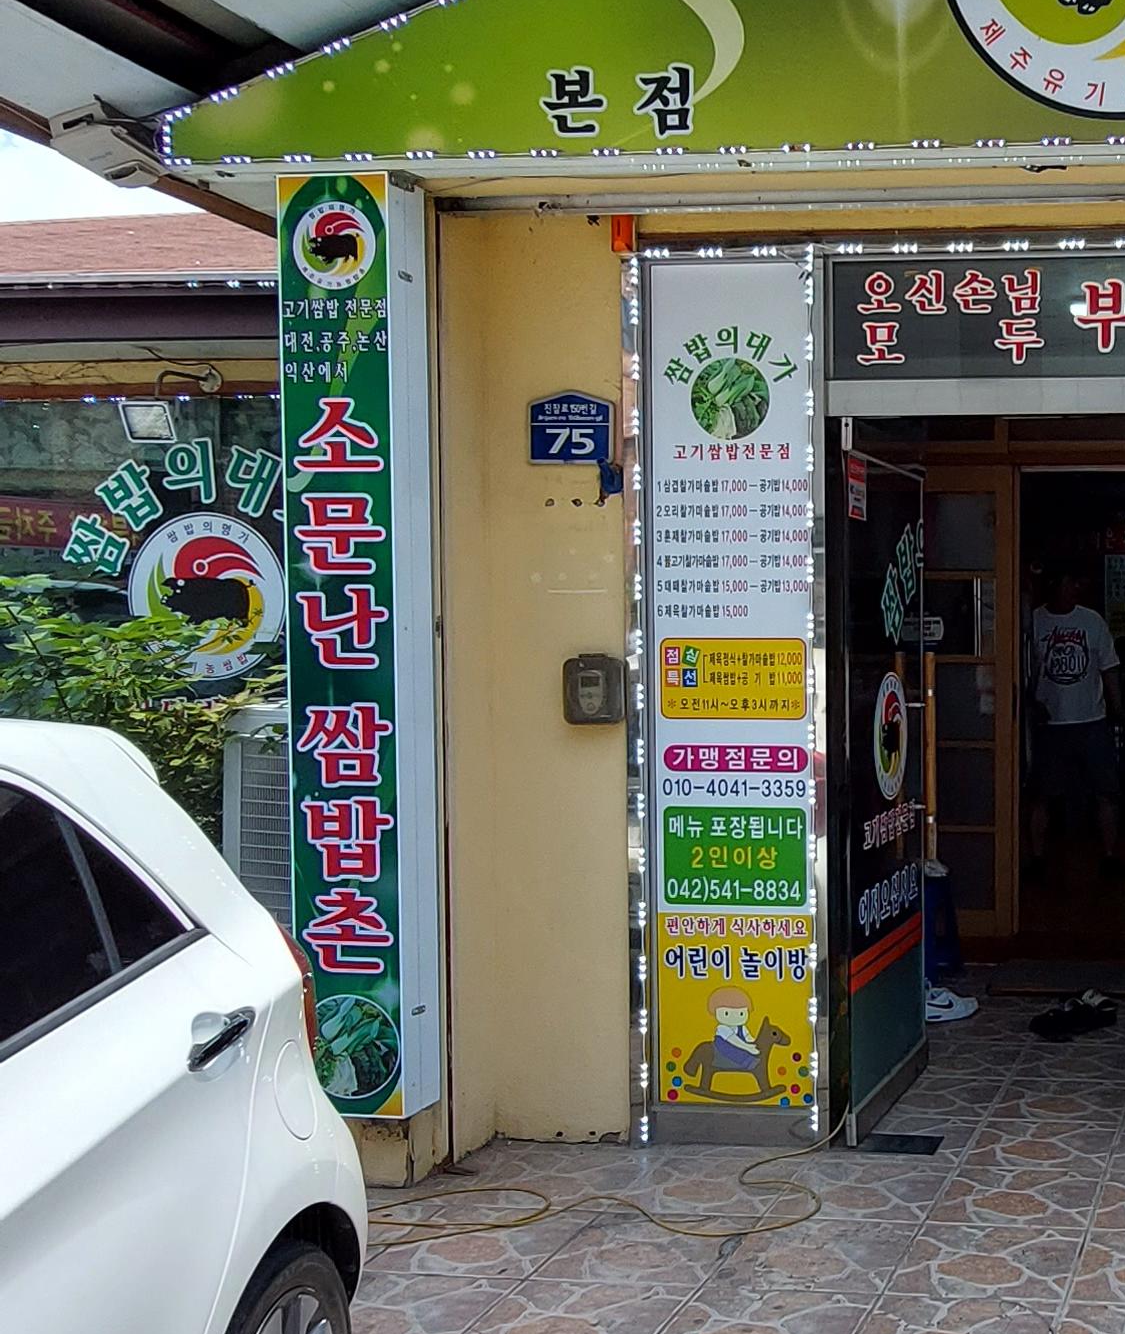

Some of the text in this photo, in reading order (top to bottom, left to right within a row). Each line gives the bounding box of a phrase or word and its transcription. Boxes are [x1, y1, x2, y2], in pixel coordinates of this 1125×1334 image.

[857, 269, 1043, 317] 오신손님
[283, 297, 387, 319] 고기쌈밥 전문점
[663, 325, 799, 386] 쌈밥의대가
[285, 361, 349, 383] 익산에서
[545, 427, 595, 455] 75
[673, 442, 791, 461] 고기쌈밥전문점
[721, 479, 748, 493] 17,000
[62, 437, 284, 577] 쌈밥의대
[721, 505, 748, 518] 17,000
[166, 519, 250, 545] 쌈밥의명가
[293, 396, 389, 671] 소문난
[721, 530, 748, 543] 17,000
[721, 555, 748, 568] 17,000
[721, 580, 748, 594] 15,000
[721, 605, 749, 618] 15,000
[672, 747, 799, 770] 가맹점문의
[662, 778, 807, 799] 010-4041-3359
[297, 701, 394, 975] 쌈밥촌
[668, 815, 804, 841] 메뉴 포장됩니다
[667, 878, 802, 903] 042)541-8834
[665, 916, 809, 938] 편안하게 식사하세요
[664, 944, 809, 983] 어린이 놀이방
